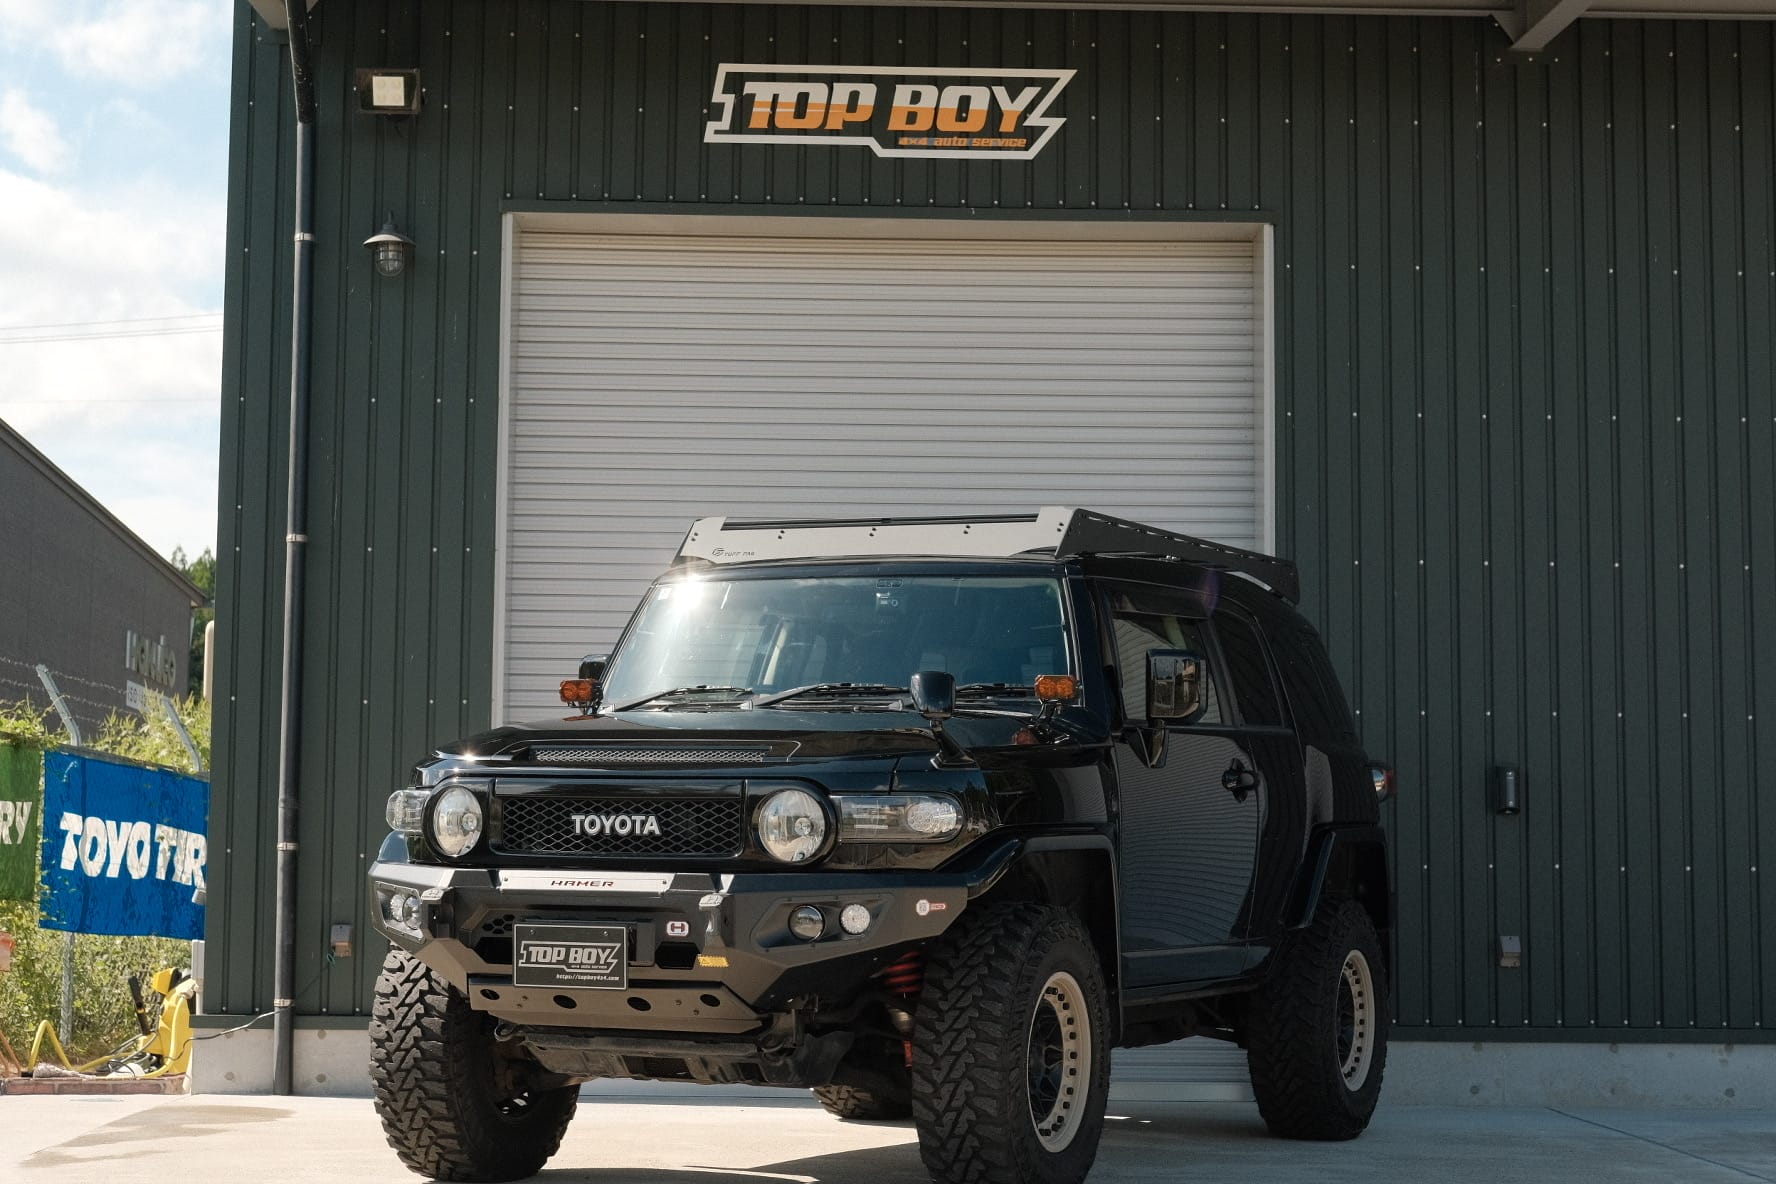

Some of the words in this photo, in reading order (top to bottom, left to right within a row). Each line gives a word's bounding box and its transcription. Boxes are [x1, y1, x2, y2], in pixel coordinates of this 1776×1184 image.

[743, 82, 877, 130] TOP
[887, 84, 1042, 133] BOY
[898, 137, 928, 146] 4x4
[934, 137, 967, 147] auto
[971, 138, 1026, 148] service
[571, 814, 661, 836] TOYOTA
[528, 946, 566, 963] TOP
[568, 947, 612, 965] BOY
